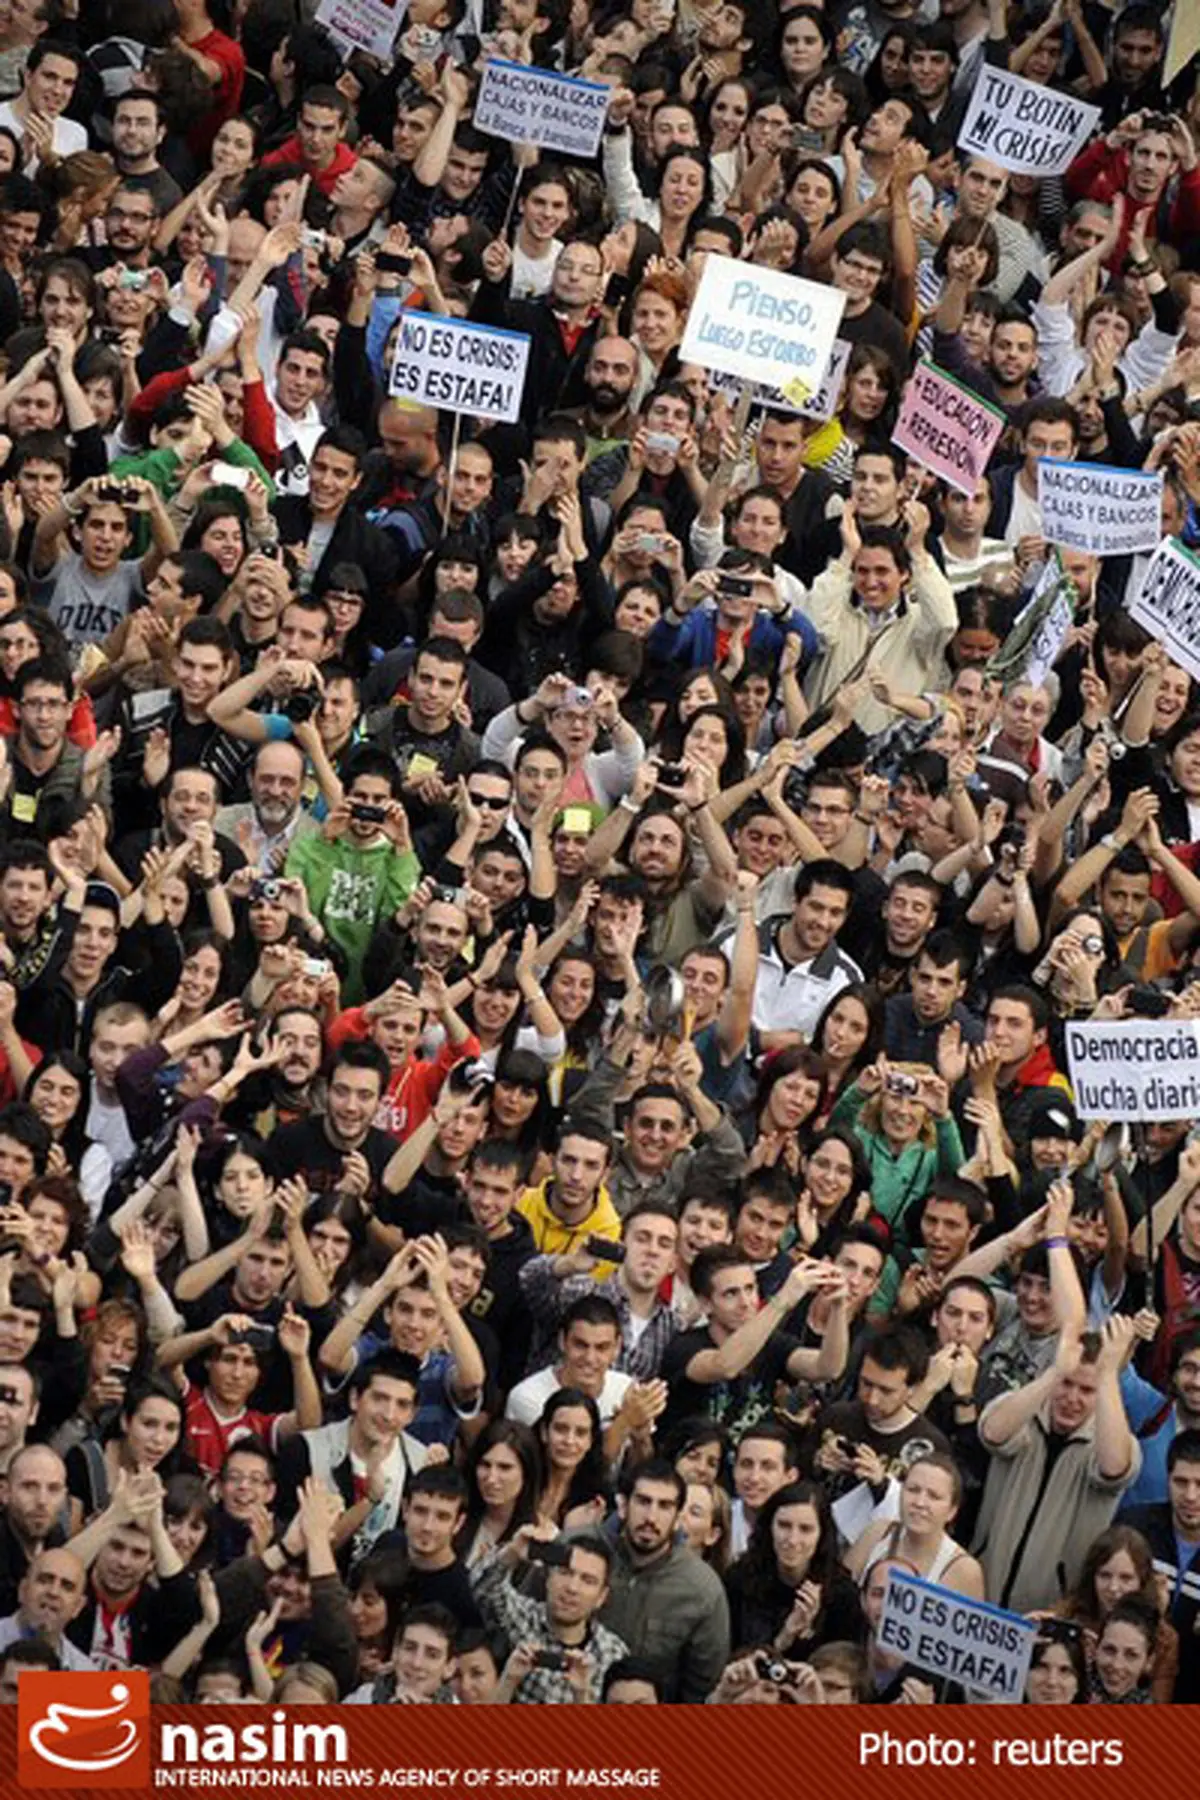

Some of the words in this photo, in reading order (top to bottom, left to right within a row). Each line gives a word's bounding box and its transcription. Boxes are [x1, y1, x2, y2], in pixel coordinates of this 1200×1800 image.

[487, 69, 607, 108] NACIONALIZAR
[986, 74, 1015, 109] TU
[483, 89, 526, 116] CAJAS
[530, 101, 541, 117] Y
[541, 104, 599, 130] BANCOS
[400, 323, 426, 353] NO
[429, 329, 454, 359] ES
[456, 335, 520, 373] CRISIS:
[697, 312, 745, 351] LUEGO
[745, 329, 818, 367] ESTORBO
[393, 362, 421, 392] ES
[425, 370, 513, 412] ESTAFA!
[1043, 470, 1160, 501] NACIONALIZAR
[1042, 495, 1083, 520] CAJAS
[1087, 505, 1095, 521] Y
[1097, 505, 1157, 525] BANCOS
[1071, 1029, 1198, 1061] Democracia
[1077, 1077, 1138, 1110] lucha
[1144, 1076, 1200, 1110] diari
[888, 1583, 916, 1615] NO
[920, 1596, 948, 1628] ES
[952, 1610, 1025, 1655] CRISIS:
[881, 1618, 912, 1650] ES
[917, 1635, 1018, 1693] ESTAFA!
